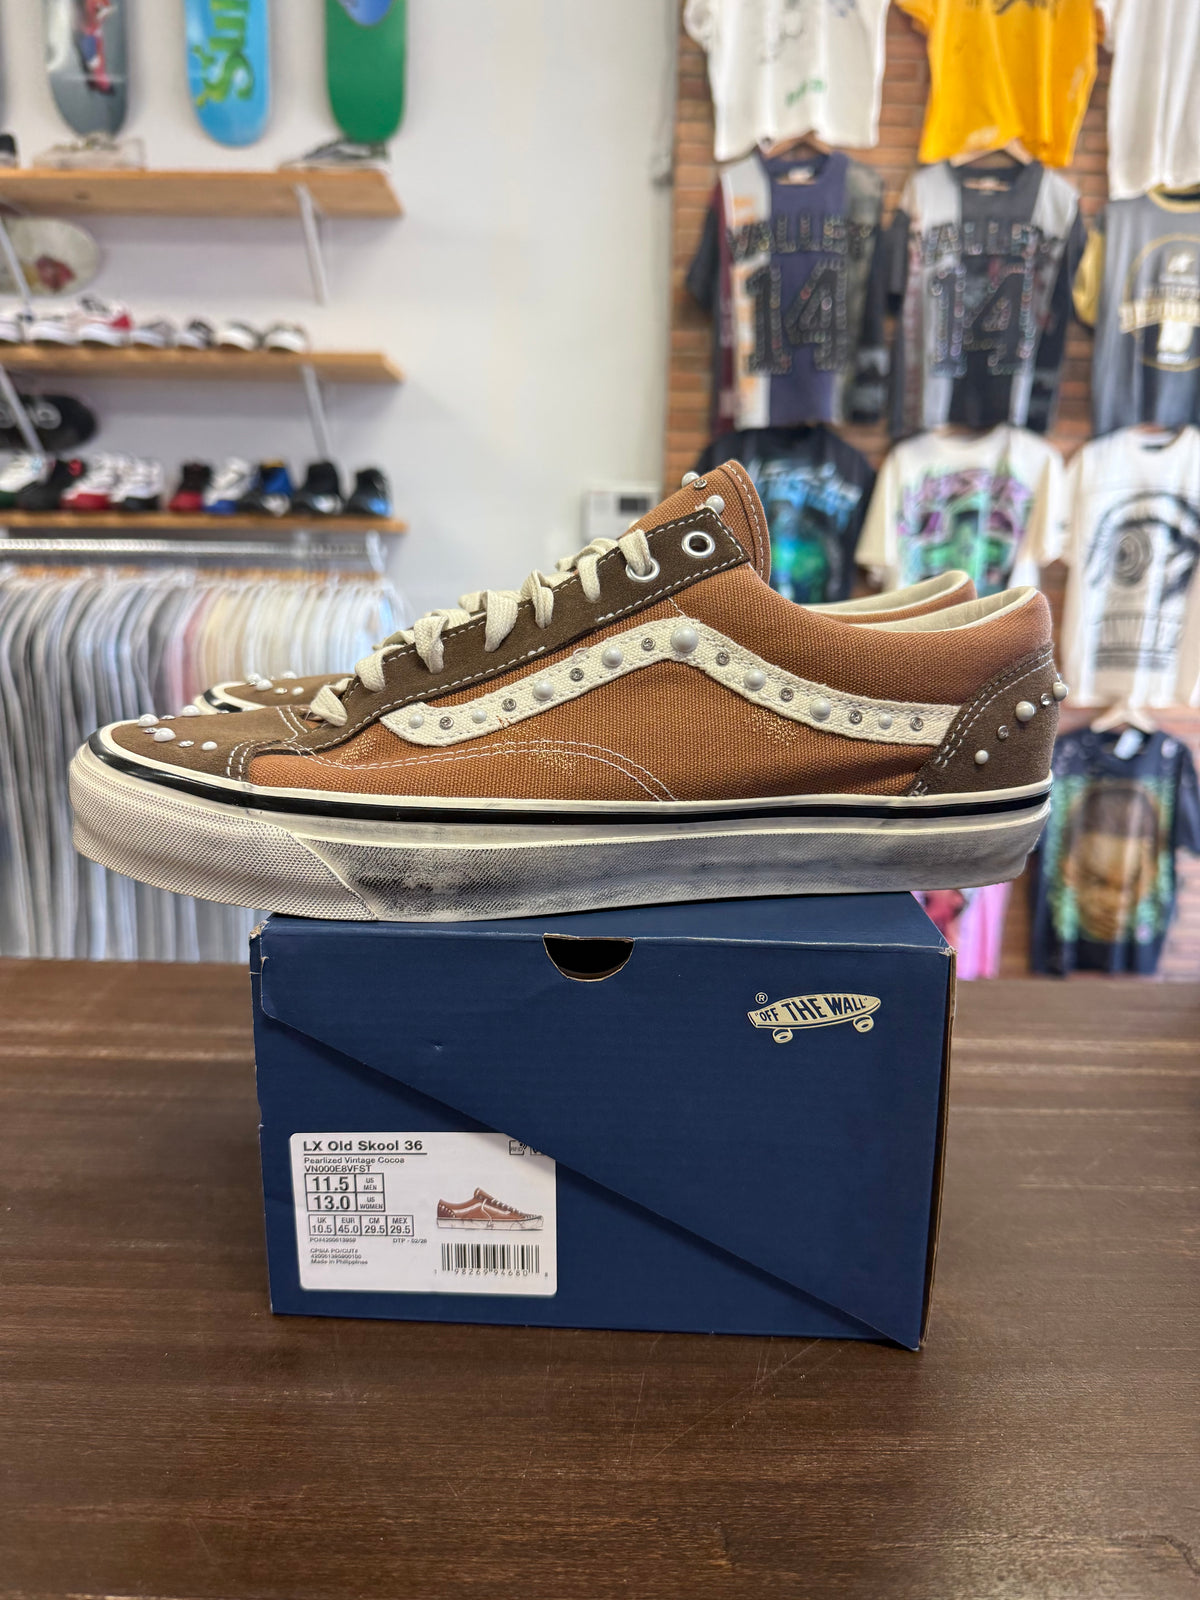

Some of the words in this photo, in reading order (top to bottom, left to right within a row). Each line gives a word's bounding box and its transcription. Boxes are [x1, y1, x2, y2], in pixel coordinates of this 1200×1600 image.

[746, 258, 850, 375] 14
[930, 262, 1036, 378] 14
[781, 998, 827, 1021] THE
[303, 1140, 323, 1151] LX
[327, 1140, 353, 1151] Old
[358, 1140, 399, 1151] Skool
[404, 1140, 423, 1151] 36
[304, 1156, 343, 1164] Pearlized
[344, 1156, 376, 1165] Vintage
[378, 1156, 405, 1164] Cocoa
[304, 1164, 372, 1172] VN000E8VFST
[313, 1176, 350, 1191] 11.5
[314, 1195, 351, 1210] 13.0
[312, 1224, 333, 1233] 10.5
[338, 1225, 359, 1233] 45.0
[365, 1225, 386, 1234] 29.5
[390, 1225, 411, 1234] 29.5
